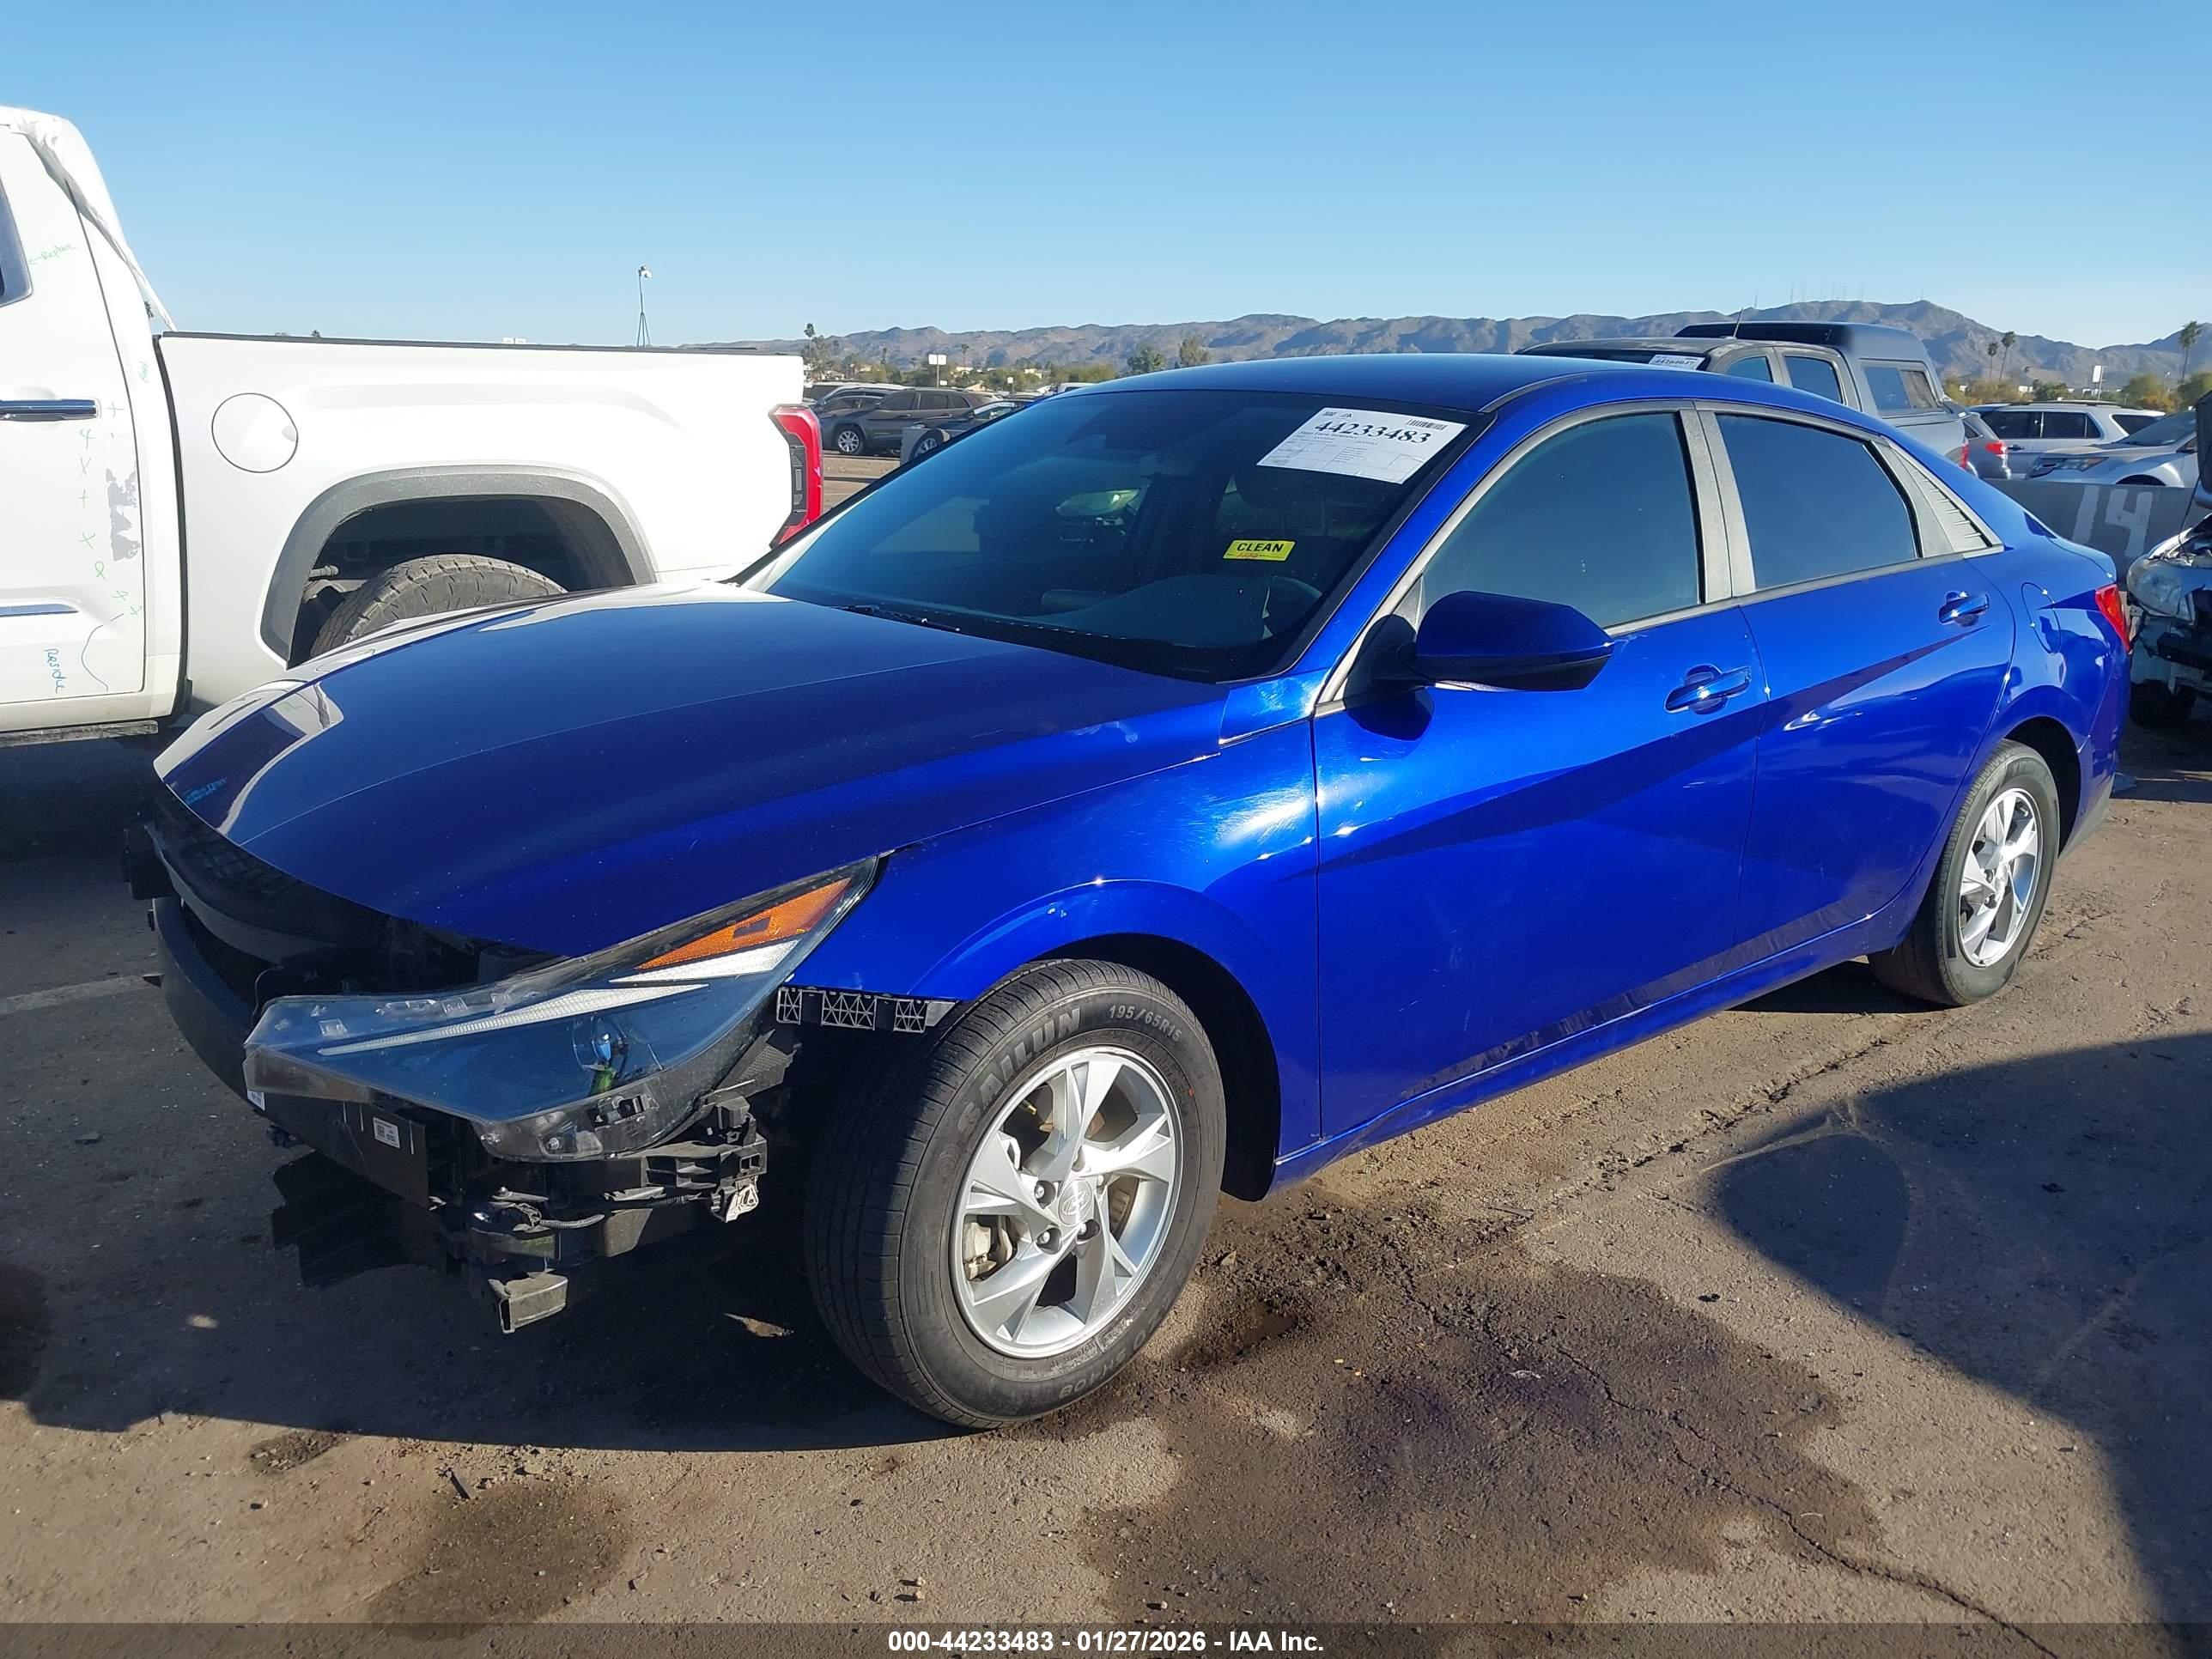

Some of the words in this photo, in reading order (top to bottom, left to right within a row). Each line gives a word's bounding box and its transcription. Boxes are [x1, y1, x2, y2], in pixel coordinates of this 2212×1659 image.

[1316, 421, 1431, 443] 44233483
[2072, 485, 2153, 557] 14
[1237, 543, 1284, 552] CLEAN
[1109, 1004, 1182, 1042] 195/65R15
